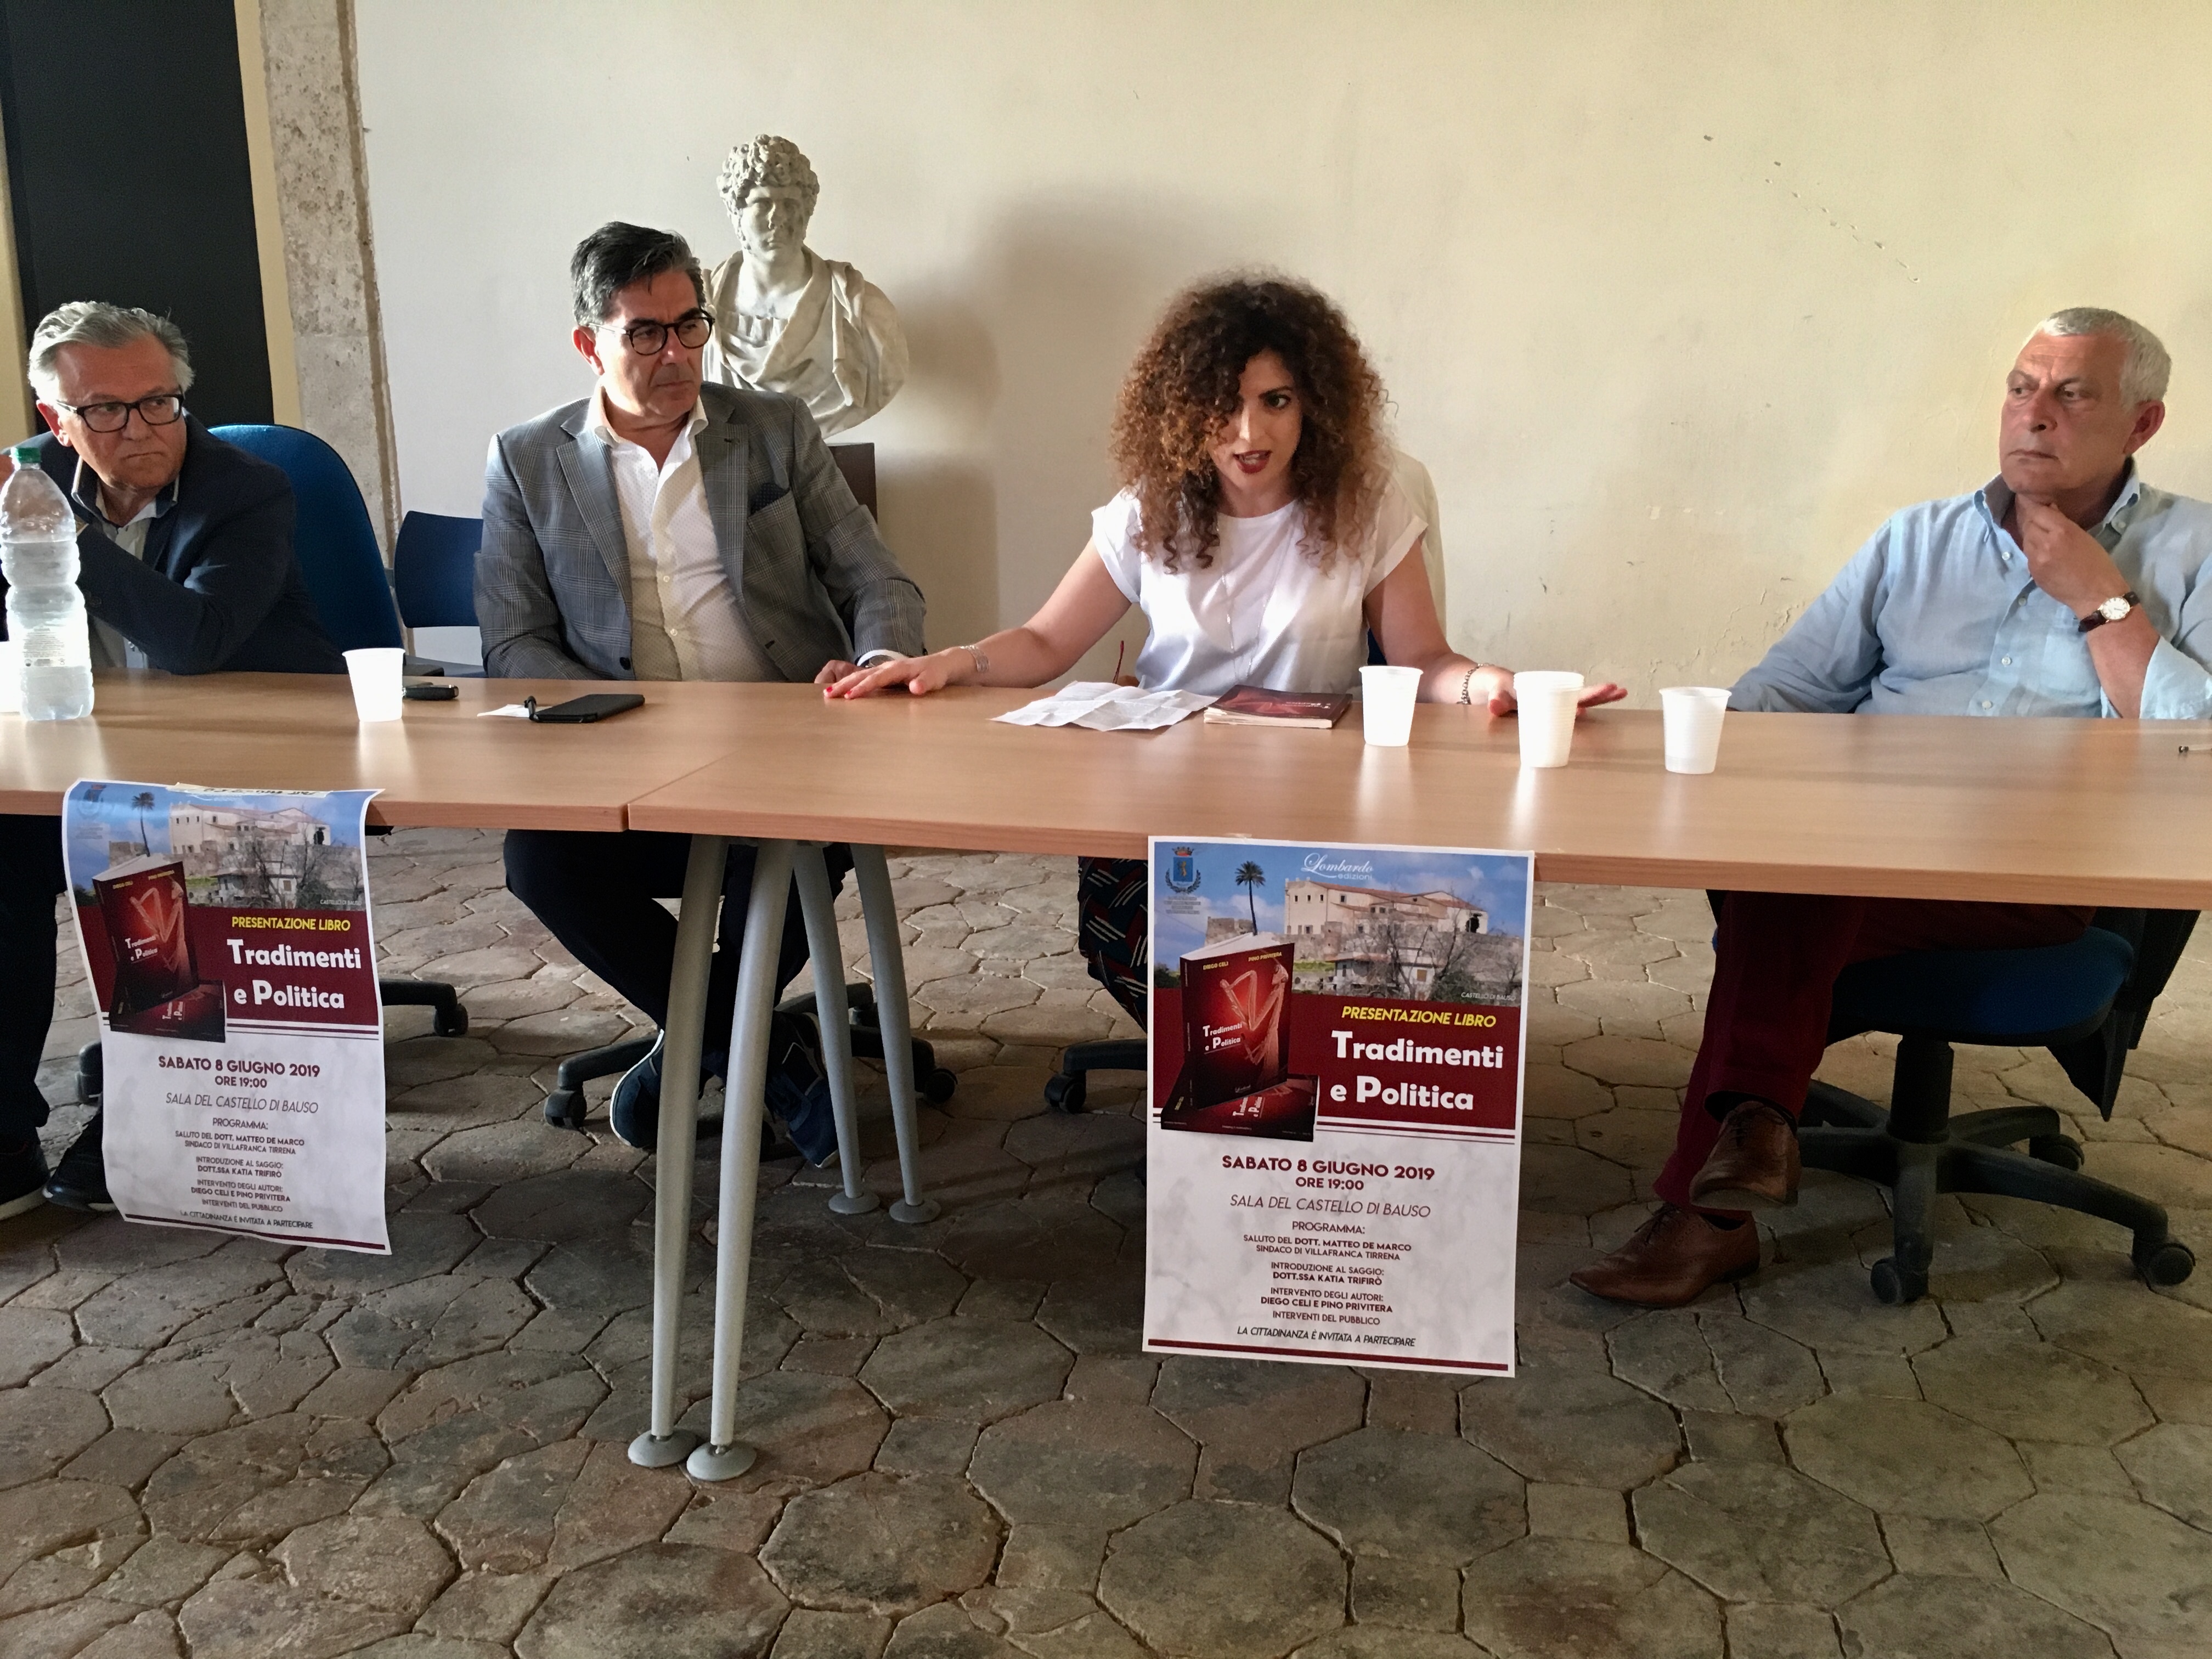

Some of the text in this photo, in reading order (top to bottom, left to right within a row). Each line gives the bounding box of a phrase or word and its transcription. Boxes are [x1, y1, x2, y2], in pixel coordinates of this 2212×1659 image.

[1301, 853, 1374, 874] Lombardo
[232, 916, 350, 932] PRESENTAZIONE LIBRO
[227, 939, 361, 969] Tradimenti
[1203, 962, 1218, 971] DIEGO
[234, 981, 345, 1008] e Politica
[1342, 1006, 1497, 1028] PRESENTAZIONE LIBRO
[1203, 1022, 1242, 1037] Tradimenti
[1212, 1036, 1241, 1049] Politica
[1331, 1031, 1503, 1068] Tradimenti
[159, 1056, 320, 1077] SABATO 8 GIUGNO 2019
[215, 1076, 267, 1088] ORE 19:00
[1330, 1085, 1346, 1102] e
[1356, 1077, 1474, 1110] Politica
[166, 1093, 318, 1113] SALA DEL CASTELLO DI BAUSO
[213, 1118, 268, 1130] PROGRAMMA:
[185, 1140, 212, 1148] SINDACO
[222, 1143, 266, 1152] VILLAFRANCA
[196, 1156, 244, 1166] INTRODUZIONE
[1223, 1155, 1435, 1180] SABATO 8 GIUGNO 2019
[198, 1165, 230, 1173] DOTT.SSA
[255, 1167, 281, 1177] TRIFIRÒ
[197, 1180, 236, 1189] INTERVENTO
[1296, 1177, 1364, 1190] ORE 19:00
[255, 1193, 290, 1201] PRIVITERA
[202, 1199, 237, 1207] INTERVENTI
[251, 1204, 283, 1212] PUBBLICO
[1231, 1194, 1430, 1217] SALA DEL CASTELLO DI BAUSO
[190, 1212, 232, 1221] CITTADINANZA
[274, 1220, 313, 1228] PARTECIPARE
[1293, 1221, 1365, 1234] PROGRAMMA:
[1295, 1238, 1320, 1246] DOTT.
[1256, 1245, 1292, 1253] SINDACO
[1305, 1248, 1362, 1258] VILLAFRANCA
[1365, 1251, 1400, 1260] TIRRENA
[1272, 1262, 1333, 1272] INTRODUZIONE
[1349, 1267, 1384, 1277] SAGGIO:
[1273, 1272, 1384, 1285] DOTT.SSA KATIA TRIFIRÒ
[1271, 1288, 1383, 1301] INTERVENTO DEGLI AUTORI:
[1261, 1297, 1289, 1305] DIEGO
[1321, 1301, 1343, 1309] PINO
[1346, 1302, 1392, 1312] PRIVITERA
[1273, 1311, 1380, 1325] INTERVENTI DEL PUBBLICO
[1251, 1327, 1308, 1339] CITTADINANZA
[1311, 1330, 1317, 1339] È
[1318, 1332, 1352, 1342] INVITATA
[1363, 1335, 1415, 1346] PARTECIPARE
